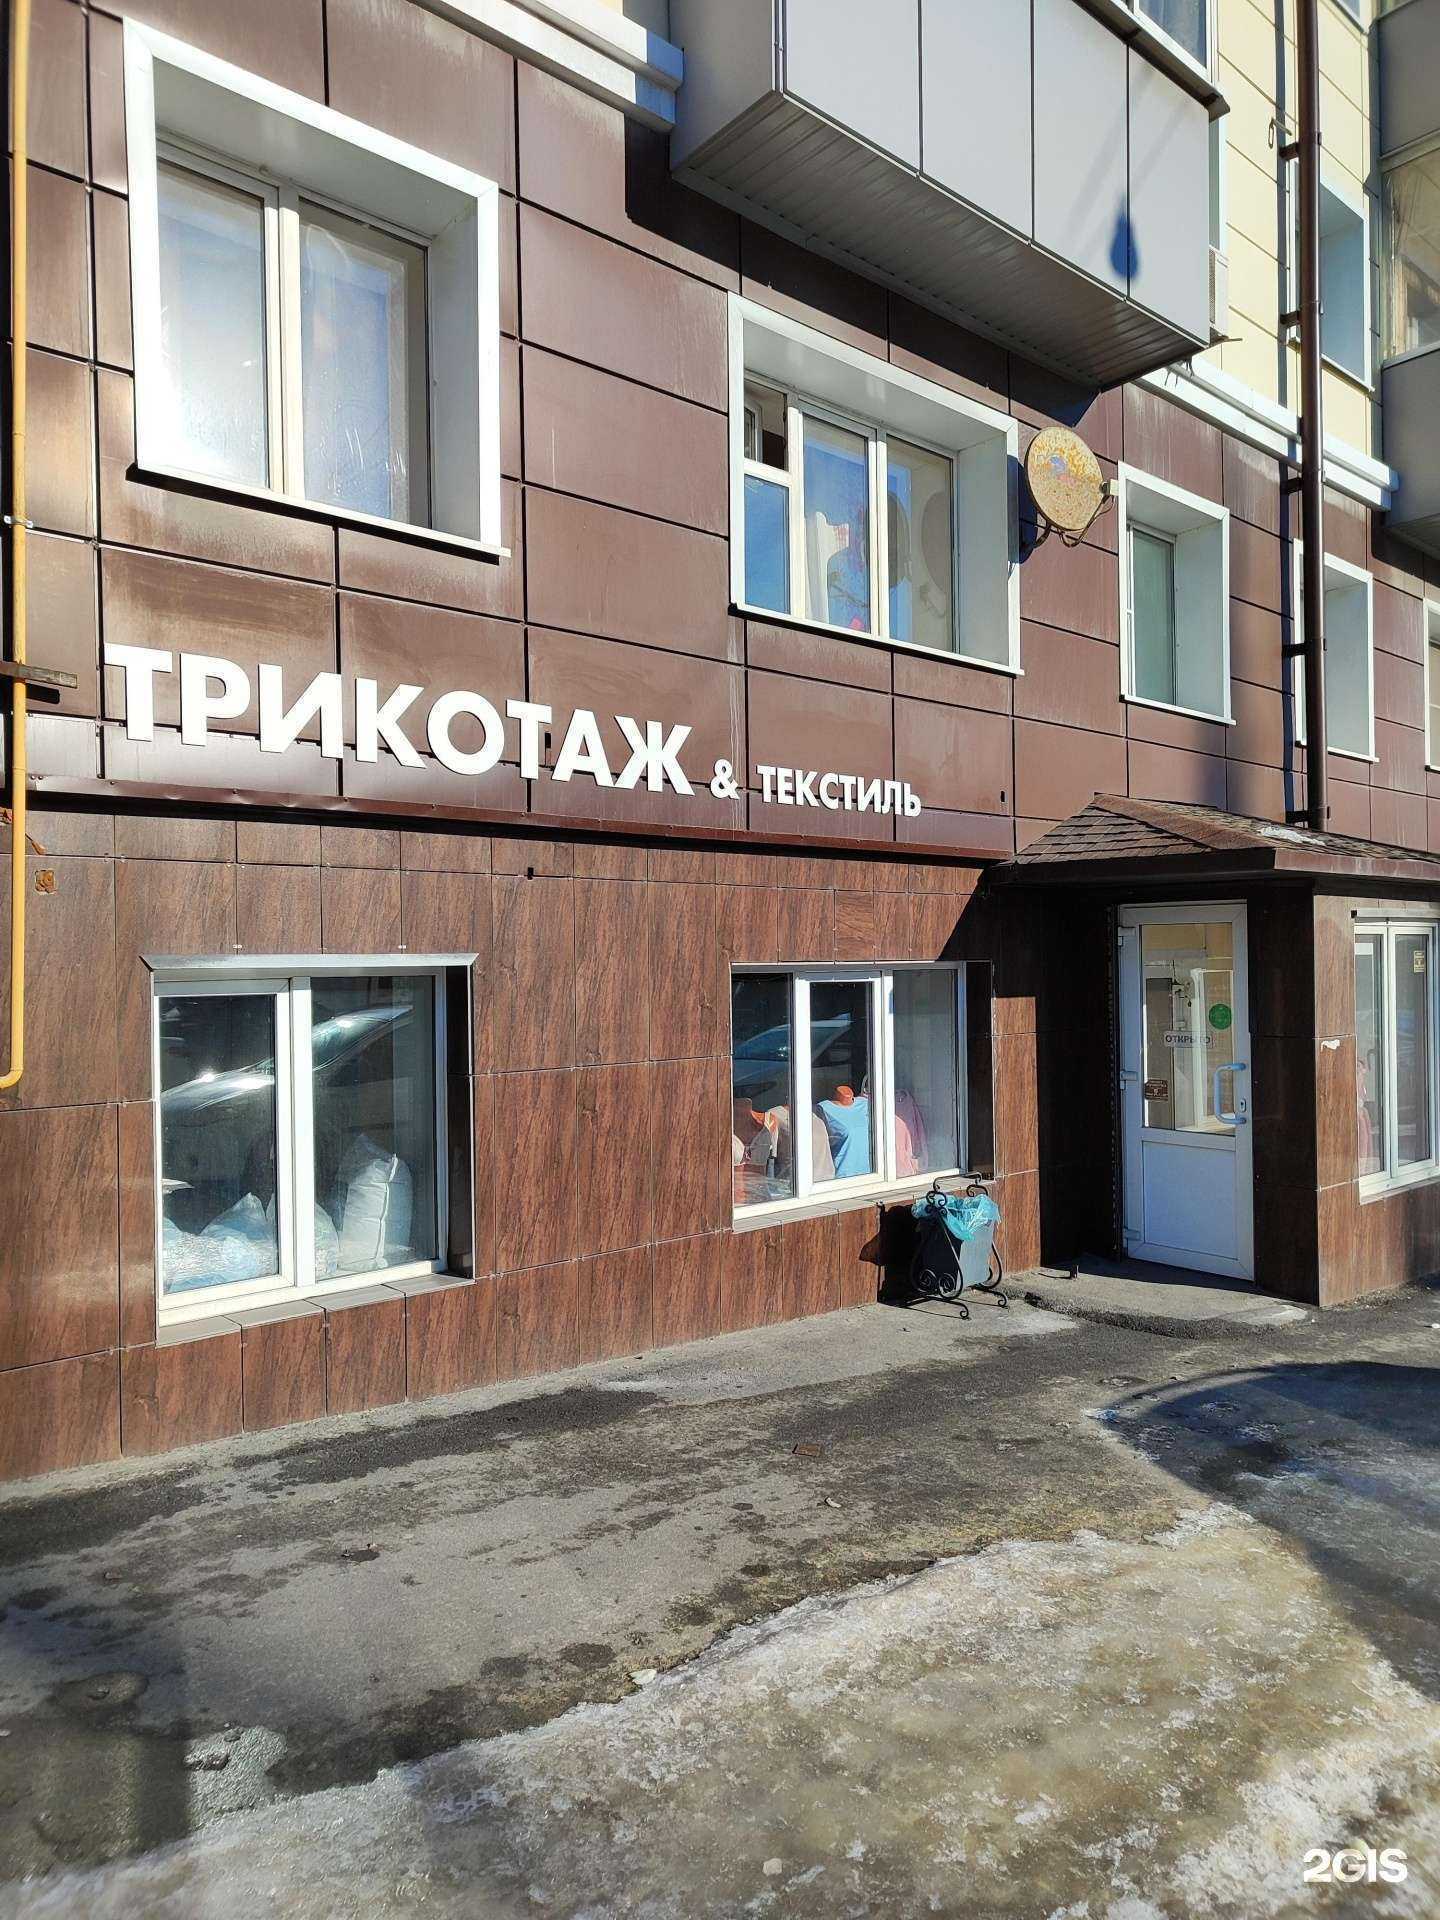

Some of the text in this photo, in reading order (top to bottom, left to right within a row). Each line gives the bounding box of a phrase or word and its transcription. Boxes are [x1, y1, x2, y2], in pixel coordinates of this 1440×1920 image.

[103, 643, 922, 817] ТРИКОТАЖ & ТЕКСТИЛЬ
[1165, 1034, 1211, 1044] ОТКРО
